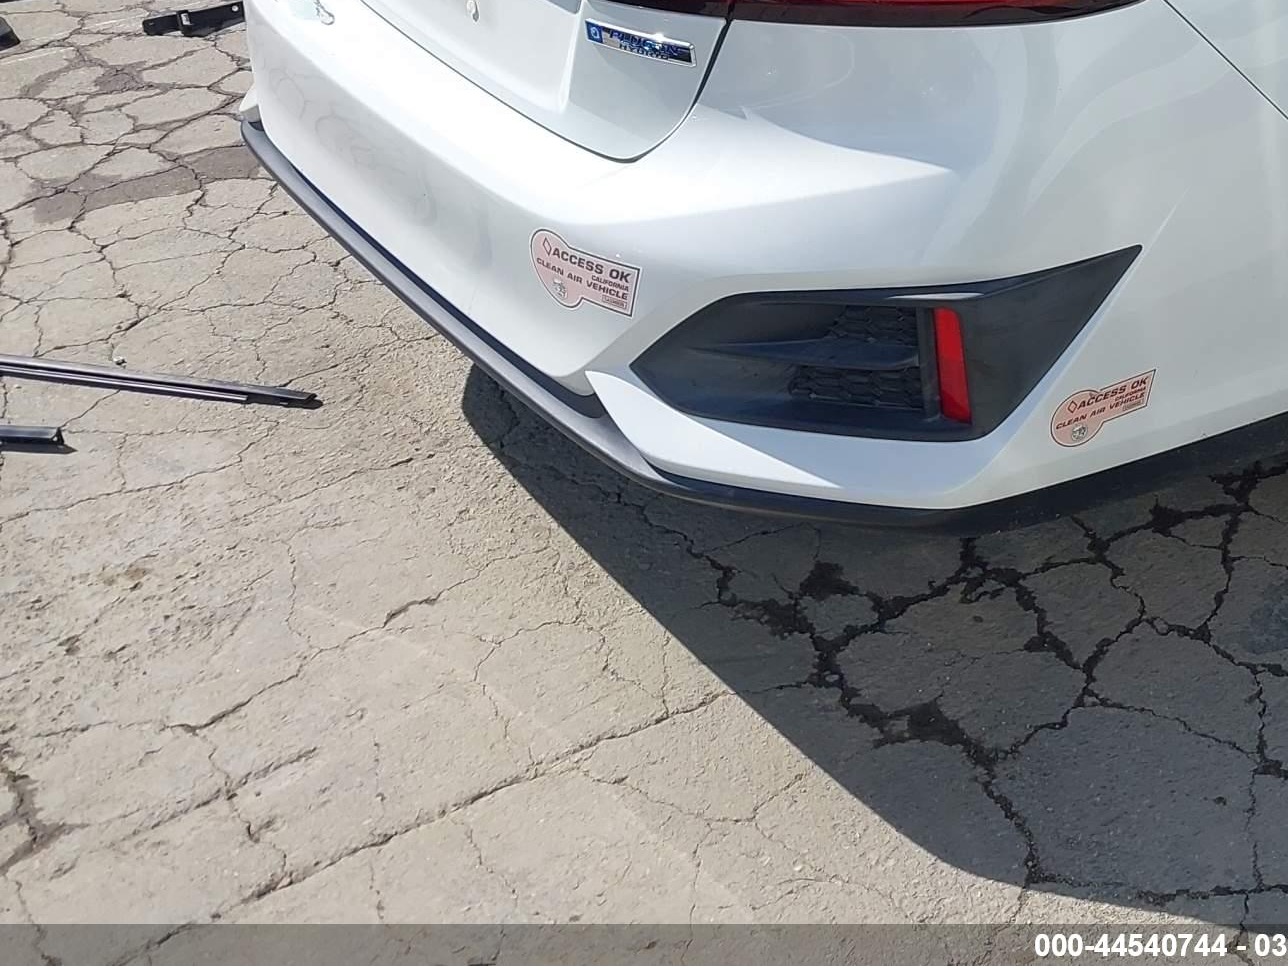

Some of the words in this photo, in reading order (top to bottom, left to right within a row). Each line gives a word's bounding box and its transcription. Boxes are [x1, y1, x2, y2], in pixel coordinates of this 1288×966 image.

[536, 257, 564, 276] CLEAN
[567, 272, 583, 284] AIR
[586, 280, 628, 300] VEHICLE
[552, 247, 603, 275] ACCESS
[609, 268, 632, 283] OK
[591, 275, 629, 292] CALIFORNIA
[1055, 413, 1087, 430] CLEAN
[1090, 406, 1106, 417] AIR
[1109, 392, 1145, 410] VEHICLE
[1077, 384, 1127, 410] ACCESS
[1131, 376, 1148, 390] OK
